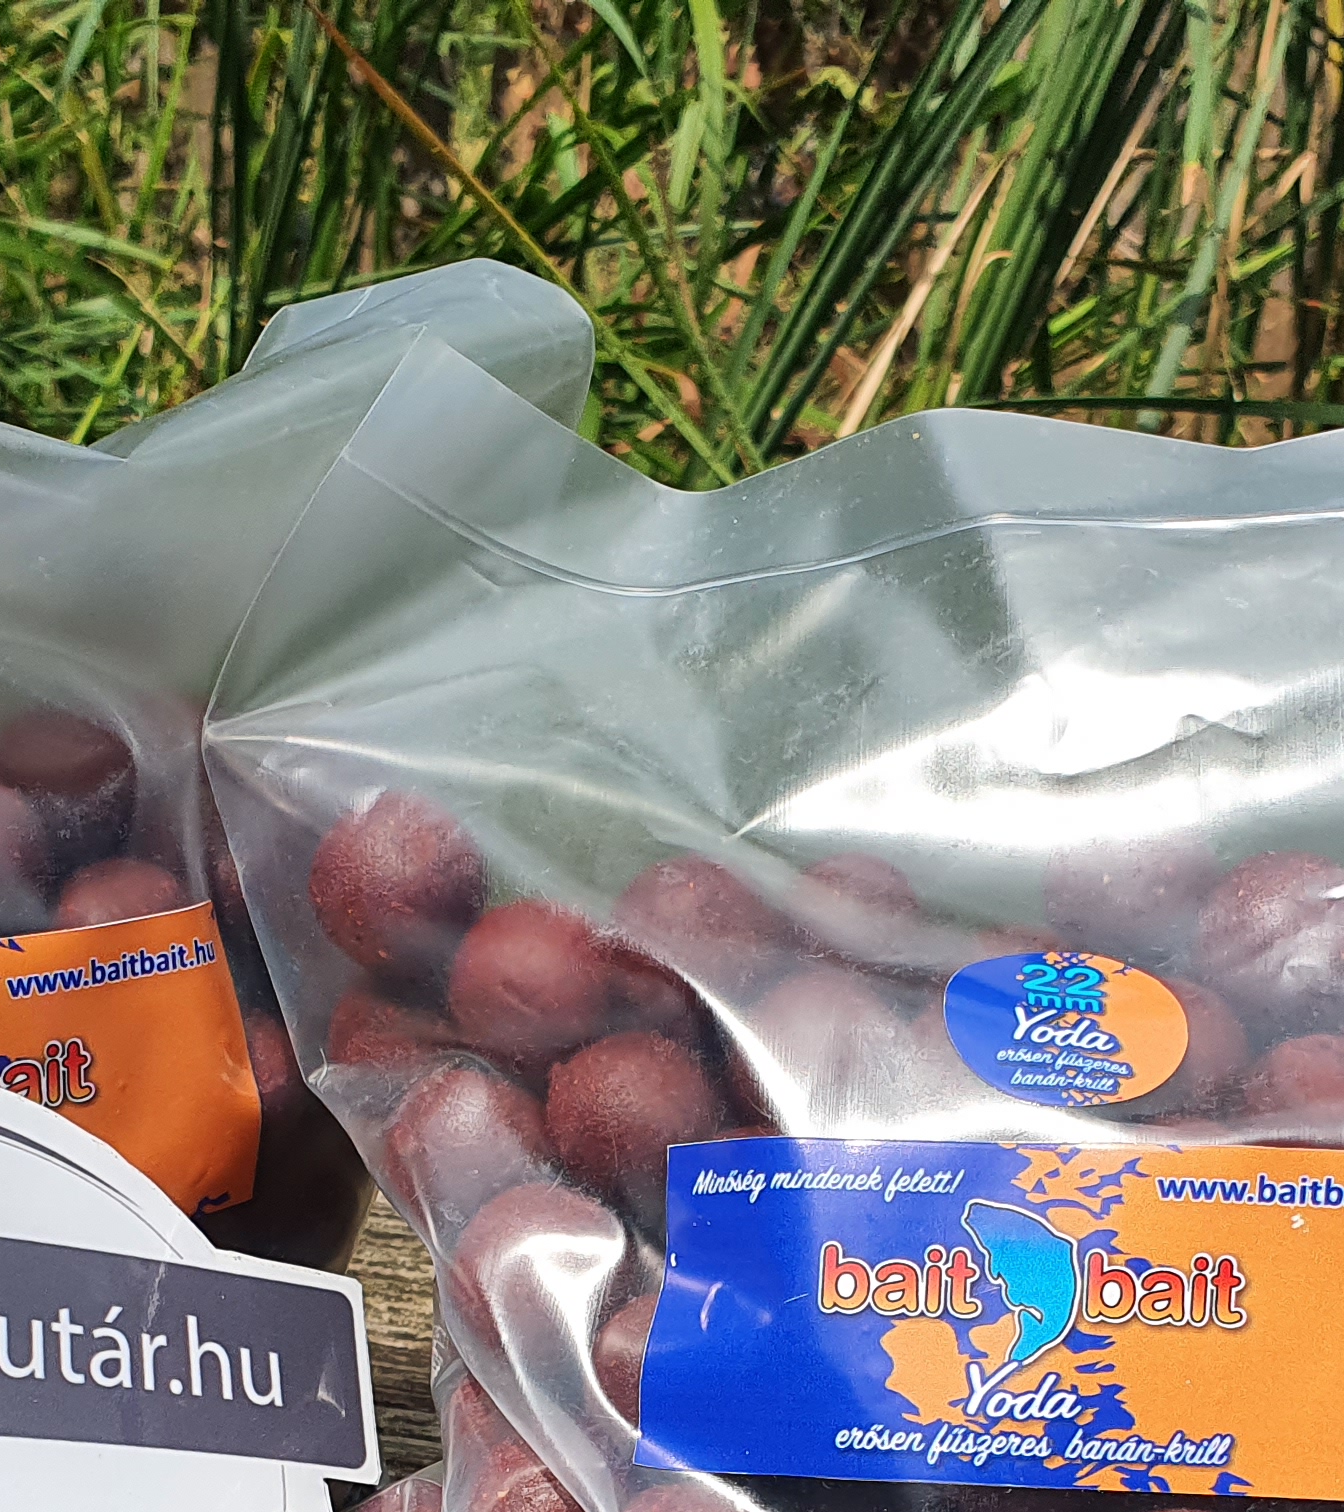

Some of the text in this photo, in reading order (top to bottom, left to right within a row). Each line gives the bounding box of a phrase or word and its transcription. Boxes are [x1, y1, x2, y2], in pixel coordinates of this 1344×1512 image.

[7, 938, 216, 999] www.baitbait.hu
[1021, 963, 1102, 997] 22
[1027, 991, 1100, 1013] mm
[1013, 1006, 1114, 1051] Yoda
[997, 1049, 1053, 1066] erősen
[1010, 1068, 1114, 1092] banán-krill
[693, 1167, 963, 1201] Minőség mindenek felett!
[819, 1242, 1246, 1329] bait bait
[965, 1362, 1083, 1419] Yoda
[834, 1424, 1229, 1466] erősen fűszeres banán-krill
